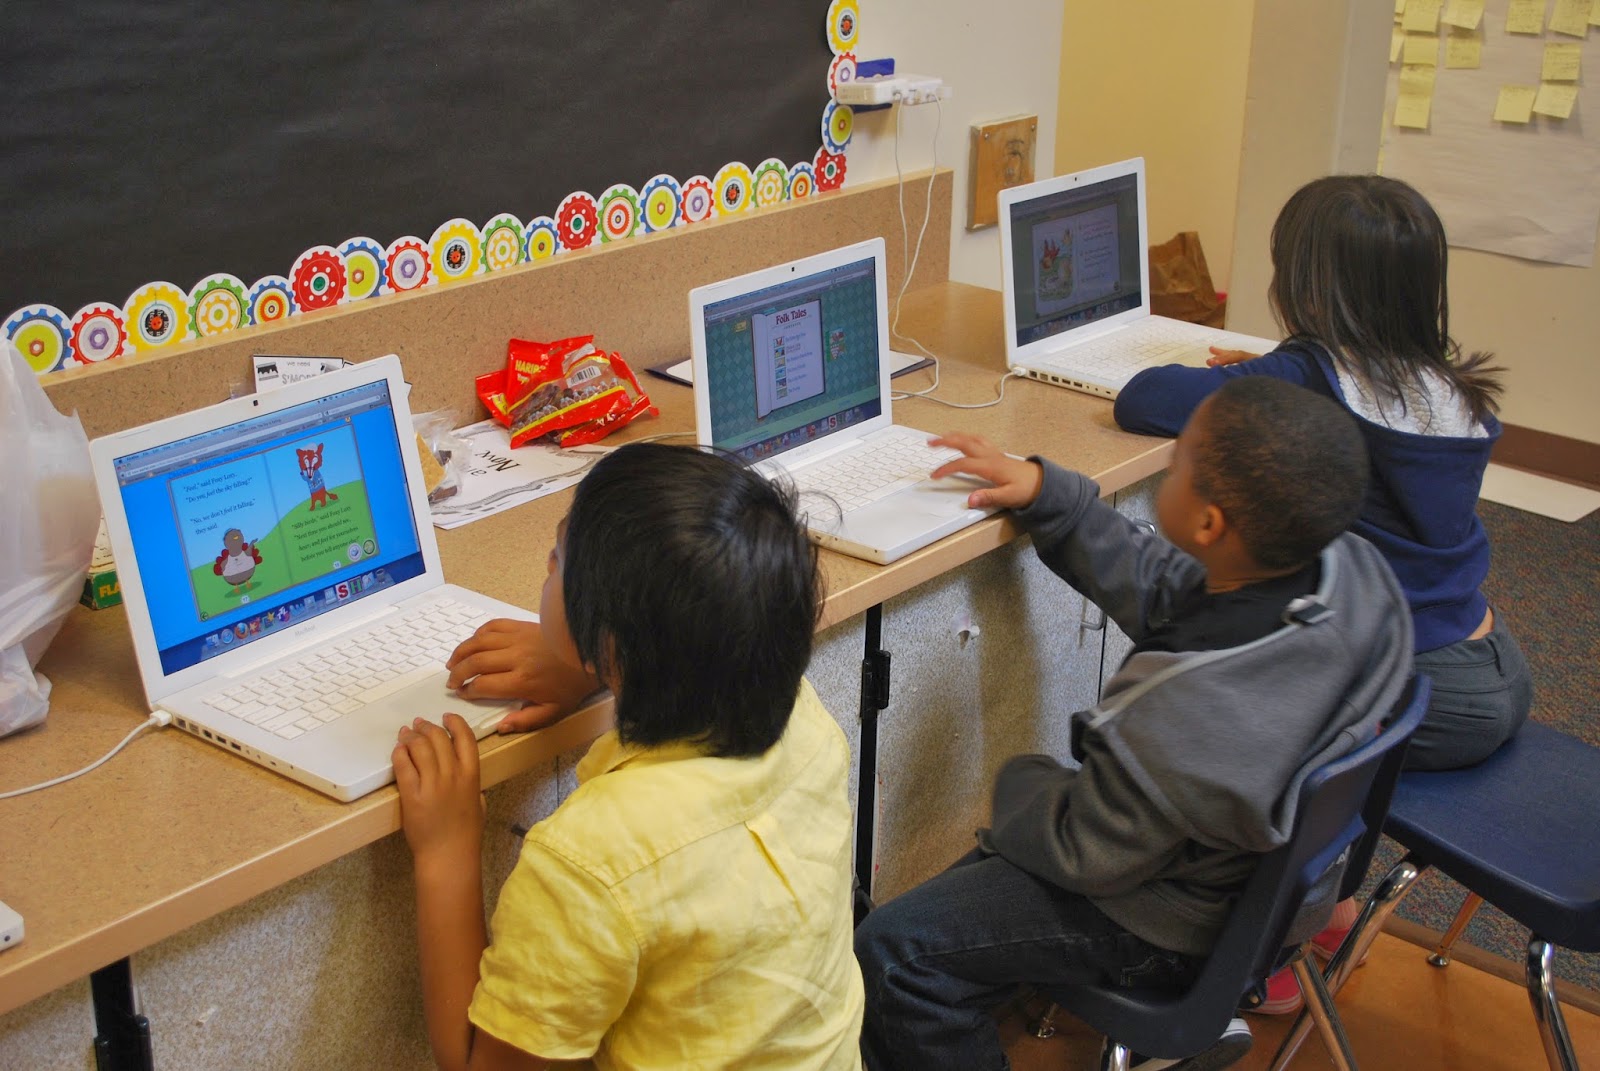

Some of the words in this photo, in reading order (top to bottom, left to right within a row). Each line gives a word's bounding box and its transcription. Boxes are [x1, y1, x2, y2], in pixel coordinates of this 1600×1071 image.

[776, 314, 790, 325] Folk
[791, 309, 806, 319] Tales
[830, 417, 836, 427] S
[475, 450, 520, 471] Now
[206, 490, 215, 498] feel
[211, 510, 223, 518] don't
[223, 507, 232, 515] feel
[328, 521, 342, 529] should
[320, 537, 328, 545] feel
[301, 554, 315, 562] before
[333, 542, 348, 550] anyone
[338, 585, 348, 598] S
[350, 579, 362, 594] H
